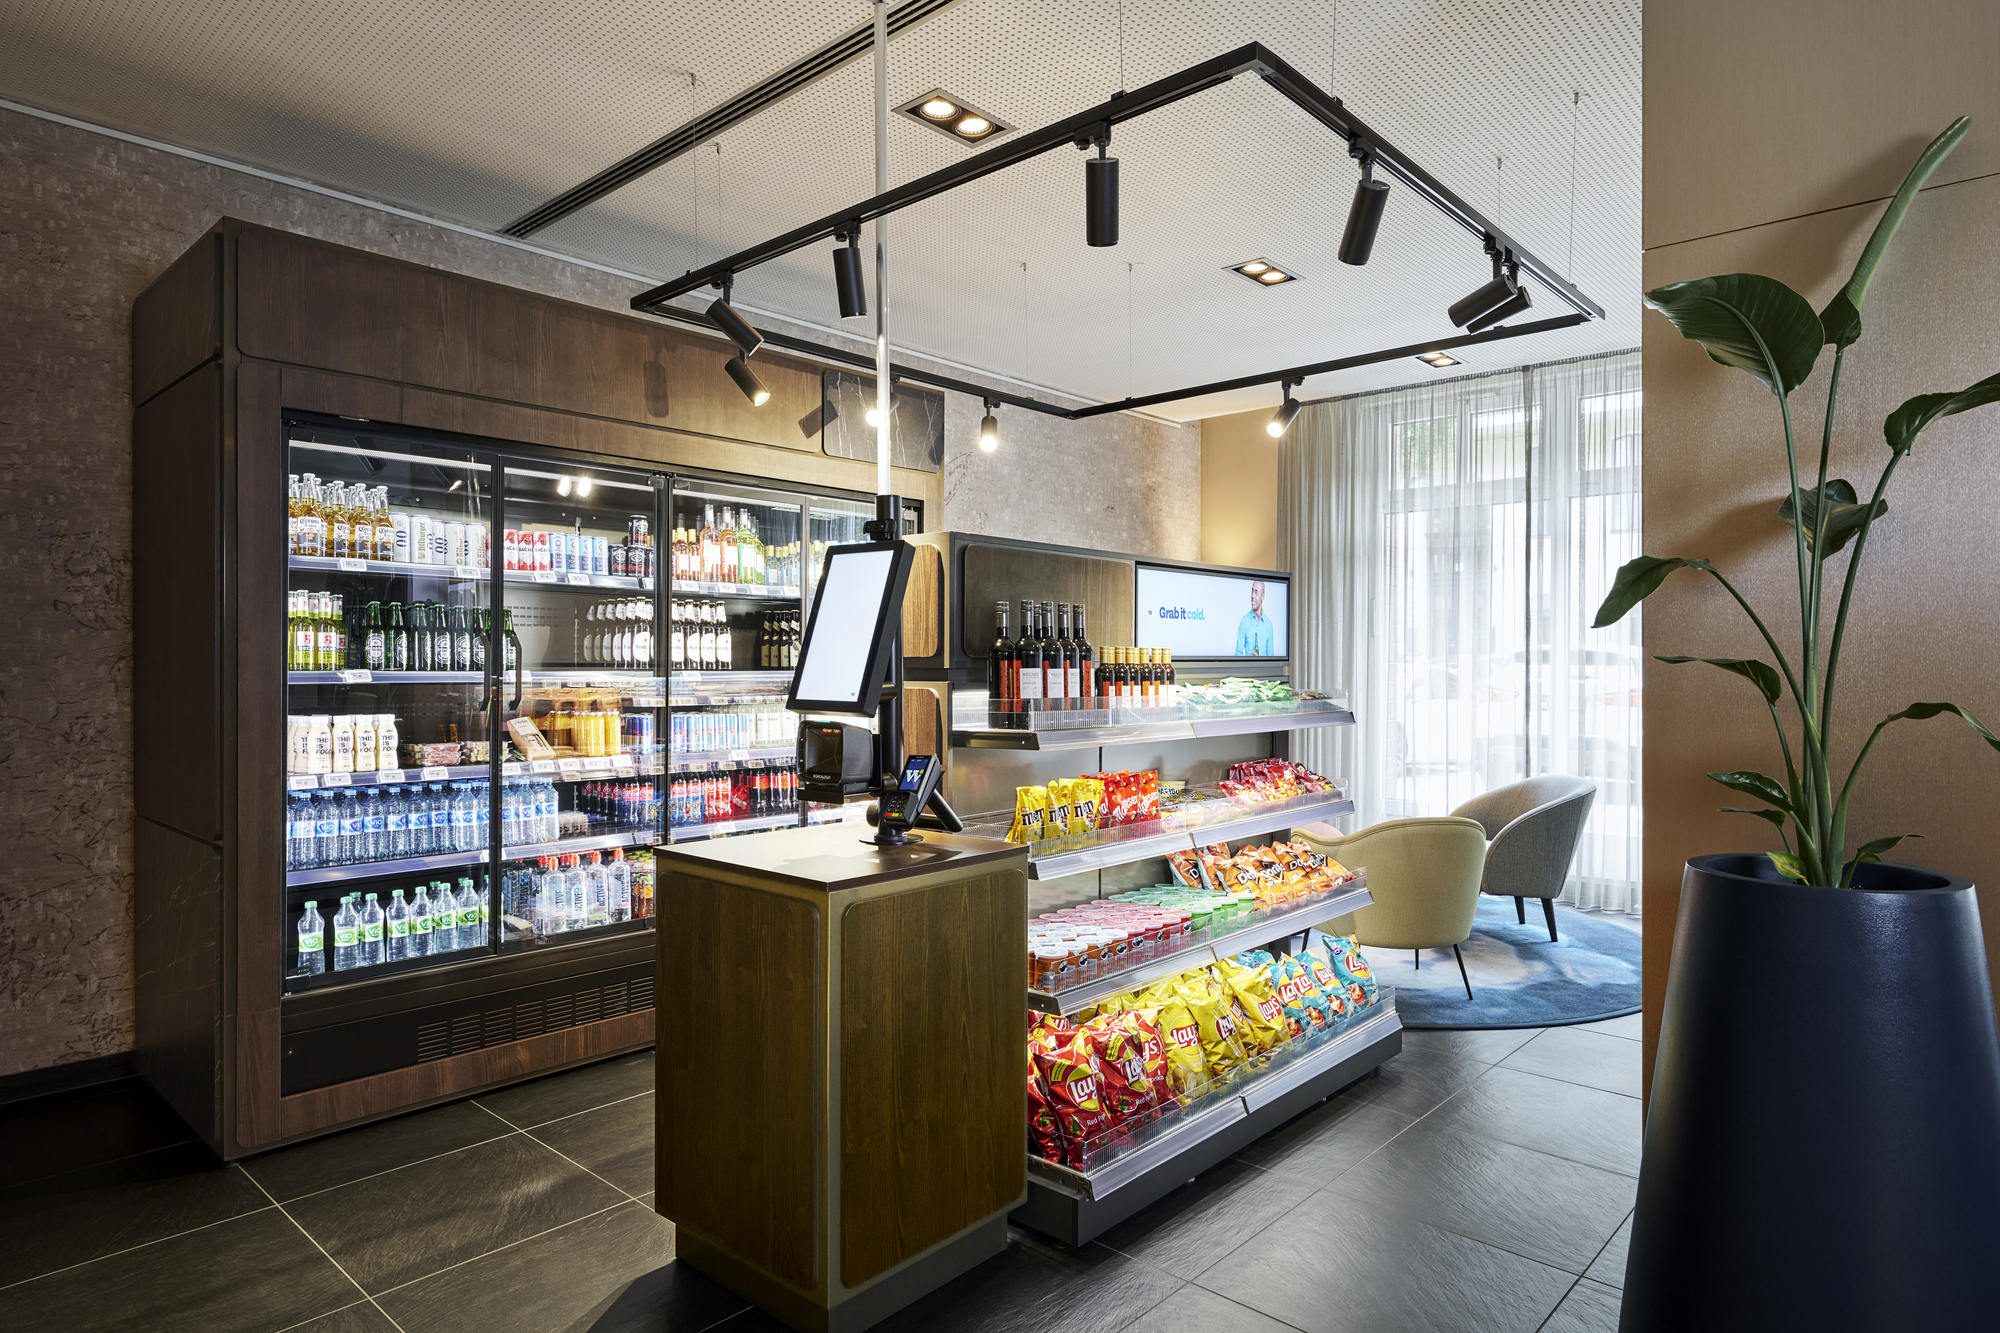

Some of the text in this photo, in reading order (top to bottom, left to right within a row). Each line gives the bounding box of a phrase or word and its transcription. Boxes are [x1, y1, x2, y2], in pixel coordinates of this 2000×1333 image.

[1159, 606, 1180, 619] Grab
[1180, 607, 1186, 620] it
[1187, 608, 1206, 620] cold.
[1258, 997, 1280, 1021] Lay's
